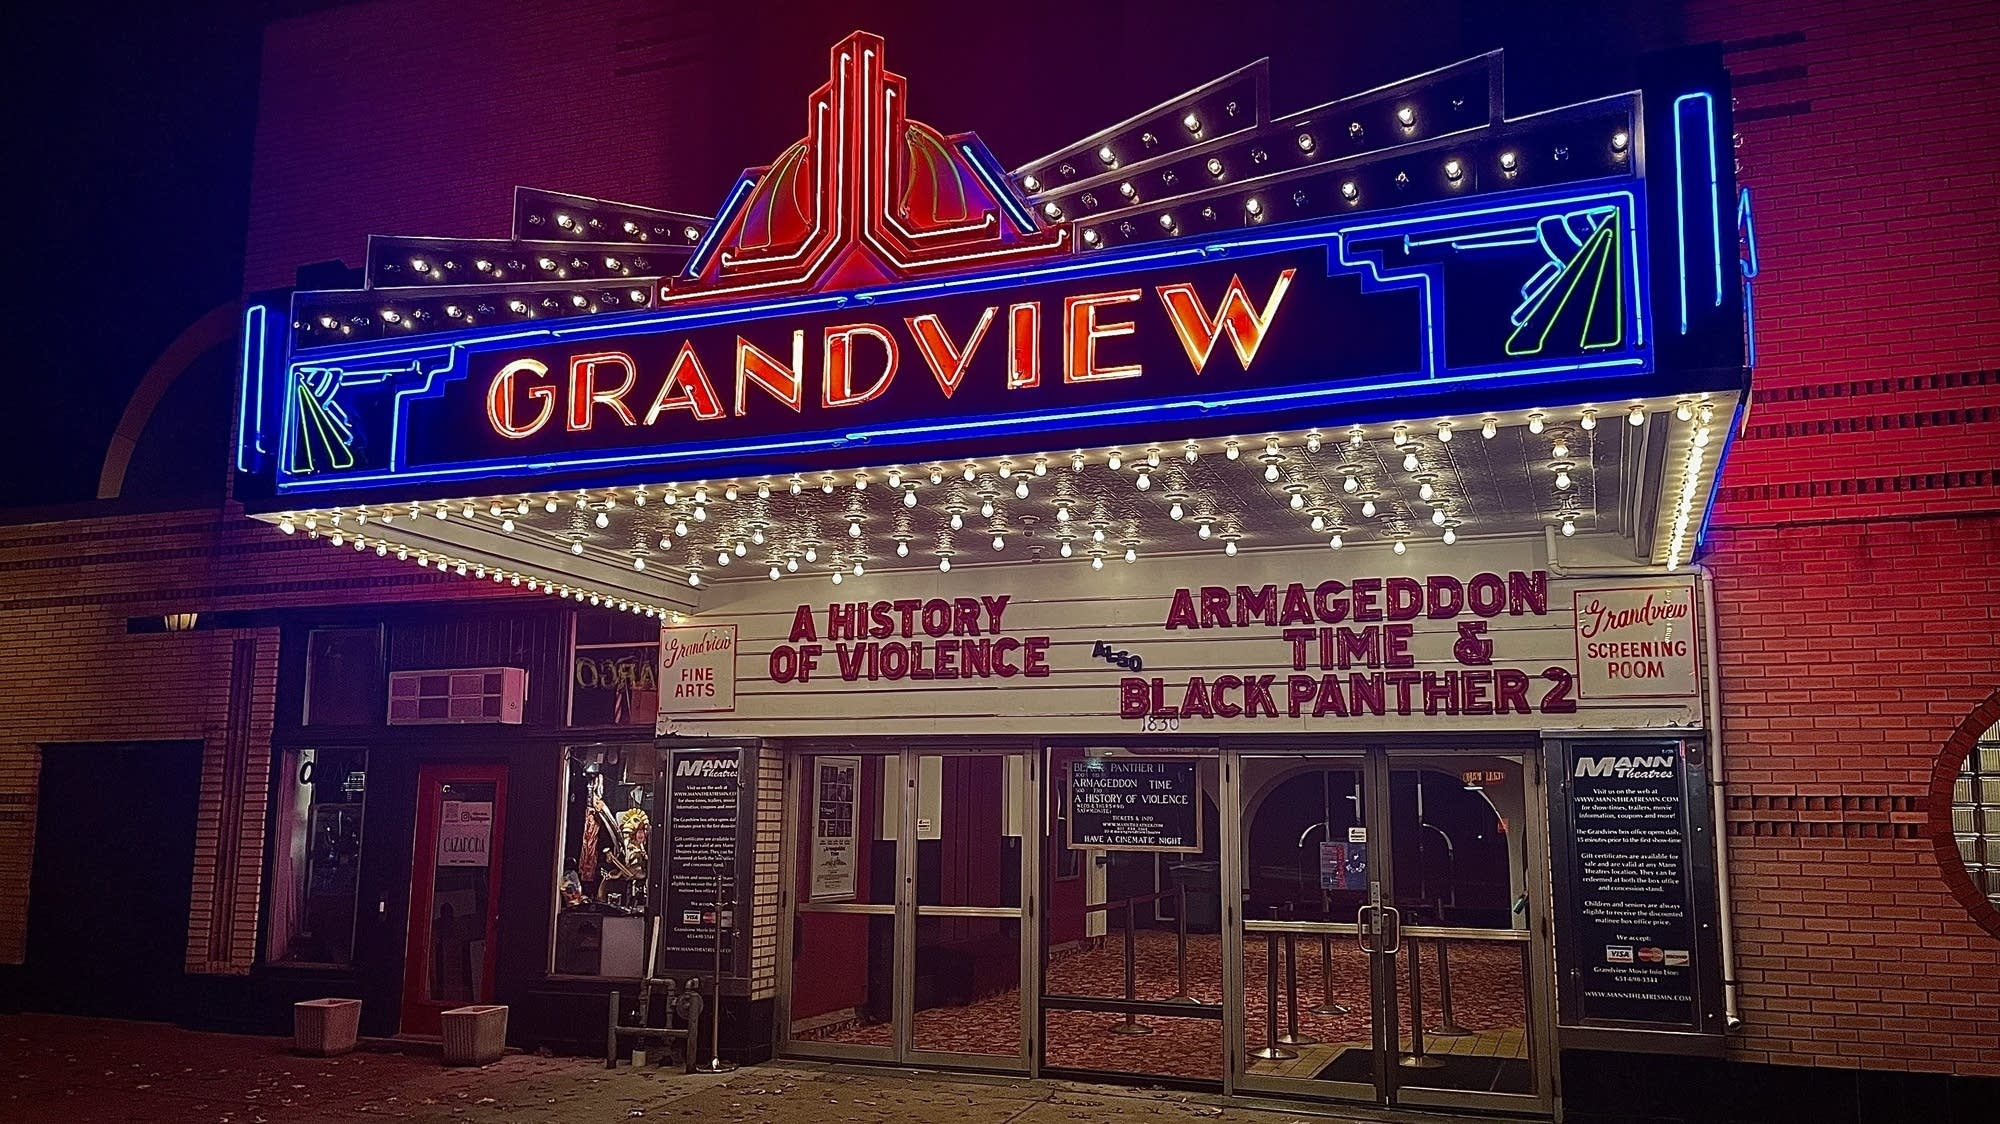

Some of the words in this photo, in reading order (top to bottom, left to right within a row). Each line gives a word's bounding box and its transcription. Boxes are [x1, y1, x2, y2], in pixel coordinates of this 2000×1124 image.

[486, 269, 1296, 438] GRANDVIEW
[1165, 571, 1548, 630] ARMAGEDDON
[789, 605, 817, 642] A
[827, 595, 1011, 640] HISTORY
[1581, 594, 1687, 638] Grandview
[664, 632, 732, 668] Grandview
[1284, 624, 1414, 670] TIME
[1454, 621, 1493, 666] &
[1587, 641, 1687, 659] SCREENING
[769, 645, 822, 683] OF
[837, 637, 1049, 680] VIOLENCE
[1092, 640, 1142, 672] ALSO
[682, 668, 714, 681] FINE
[1608, 661, 1665, 679] ROOM
[675, 683, 715, 698] ARTS
[1121, 675, 1280, 719] BLACK
[1286, 668, 1532, 718] PANTHER
[1539, 667, 1577, 714] 2
[1142, 715, 1179, 732] 1830
[676, 760, 739, 777] MANN
[701, 769, 738, 778] Theatres
[1111, 763, 1153, 773] PANTHER
[1574, 756, 1674, 777] MANN
[1615, 767, 1674, 779] Theatres
[1073, 778, 1137, 789] ARMAGEDDON
[1149, 780, 1172, 790] TIME
[1074, 794, 1082, 803] A
[1085, 794, 1123, 803] HISTORY
[1126, 795, 1138, 804] OF
[1141, 795, 1189, 805] VIOLENCE
[1084, 835, 1104, 843] HAVE
[1115, 836, 1155, 844] CINEMATIC
[1158, 837, 1182, 845] NIGHT
[1611, 950, 1630, 958] VISA
